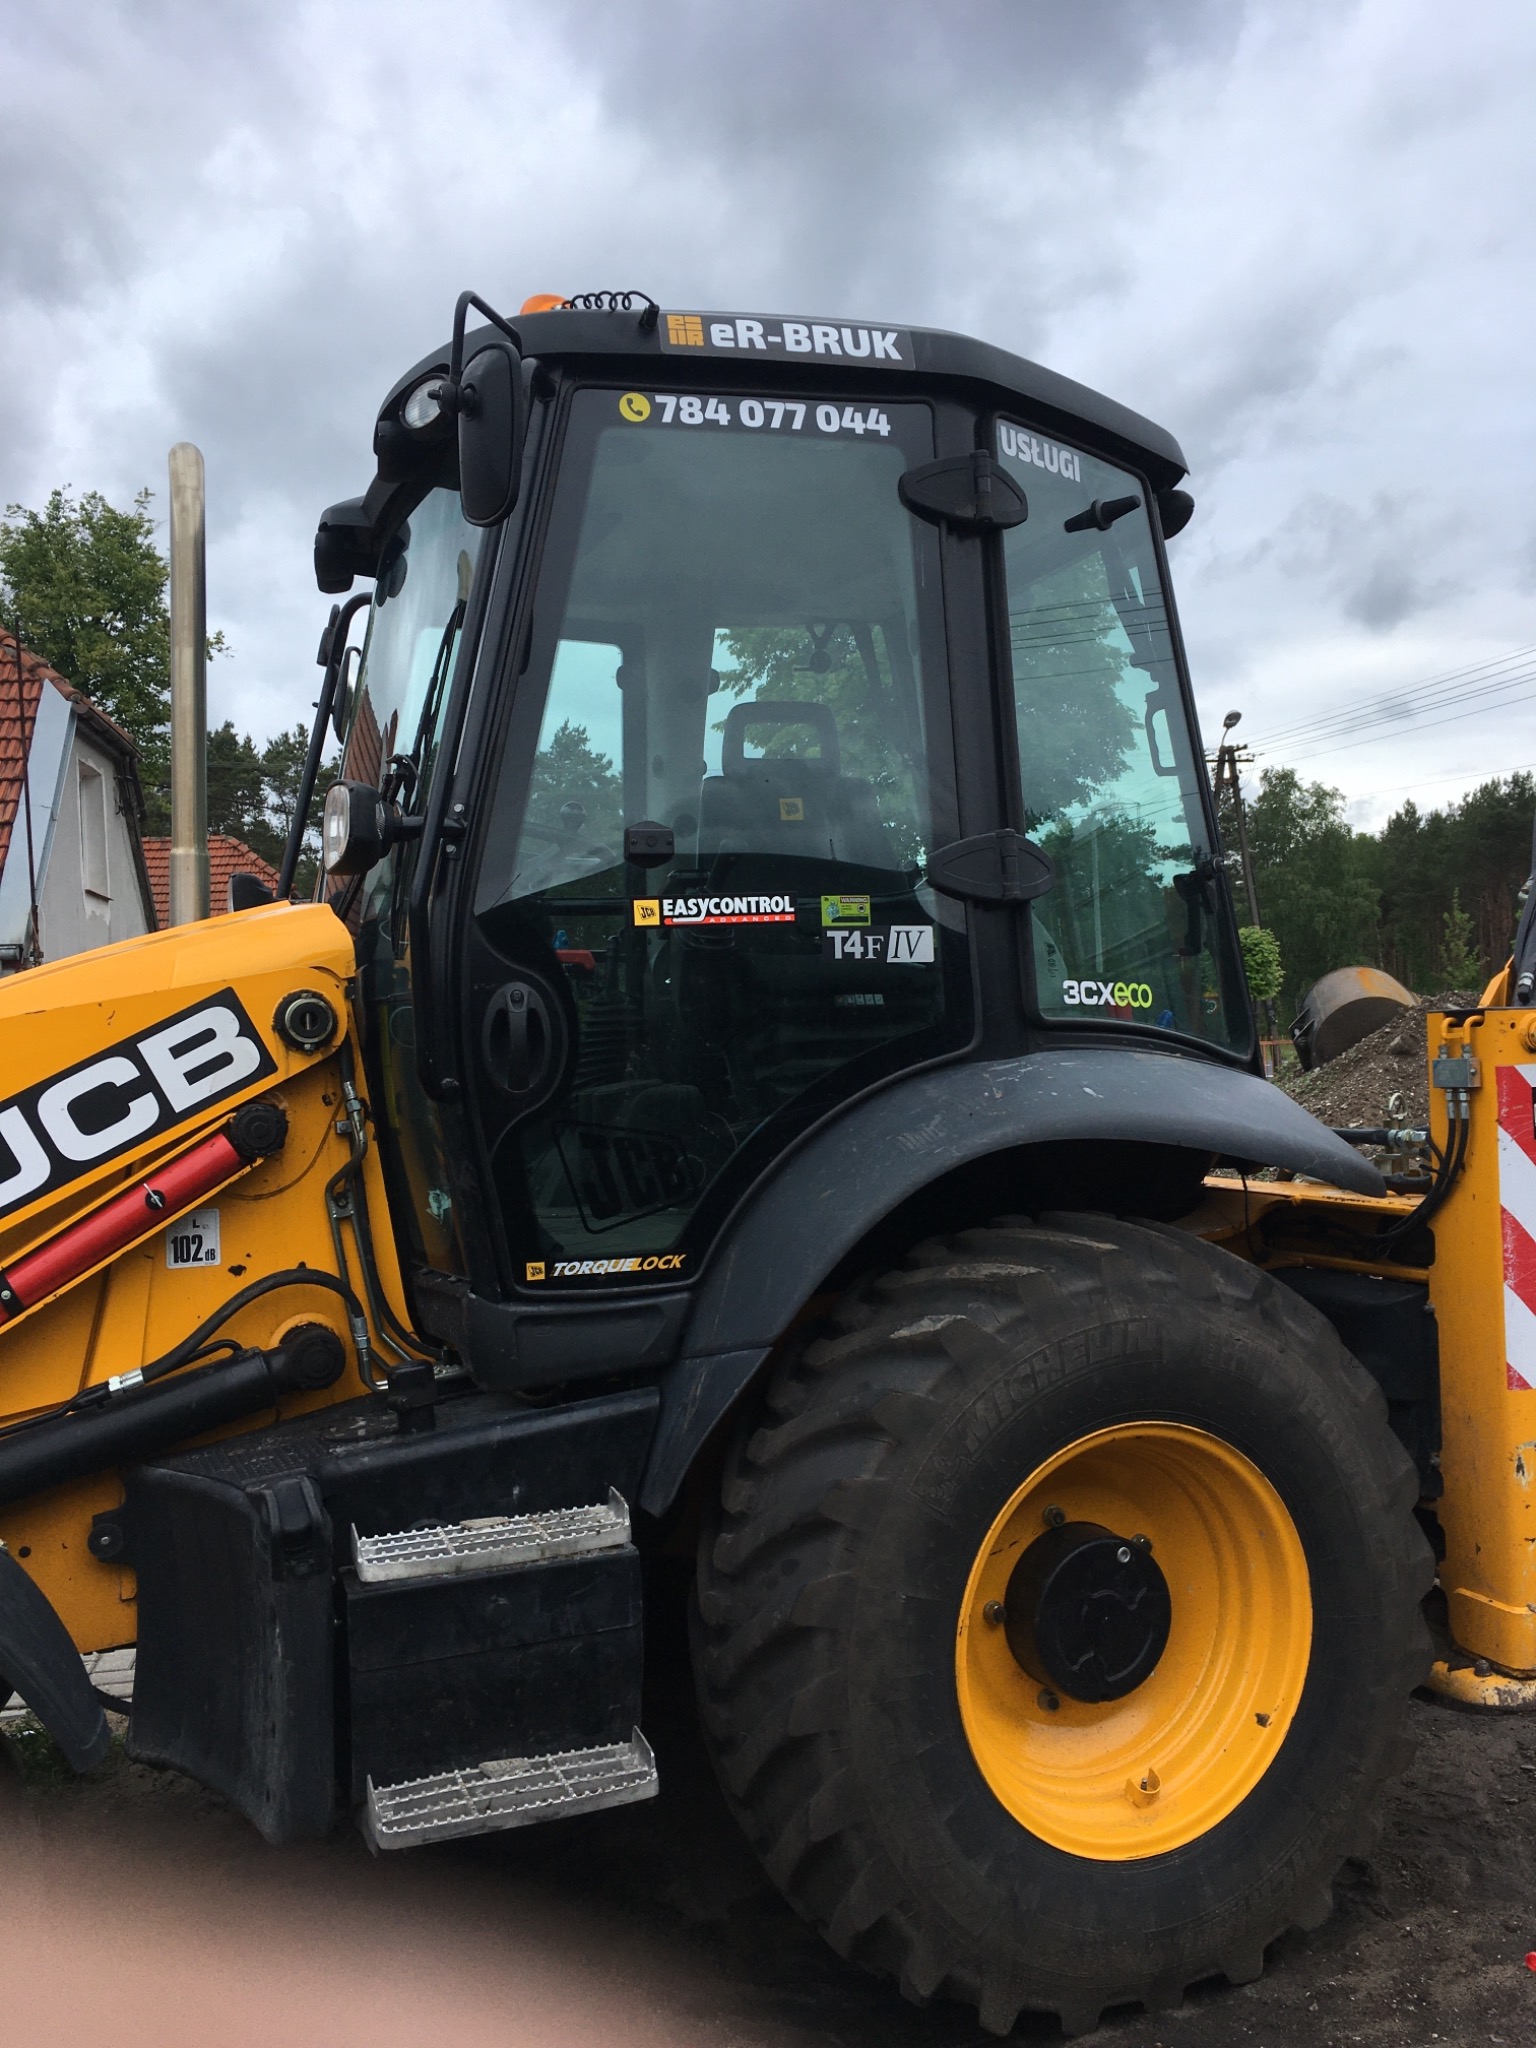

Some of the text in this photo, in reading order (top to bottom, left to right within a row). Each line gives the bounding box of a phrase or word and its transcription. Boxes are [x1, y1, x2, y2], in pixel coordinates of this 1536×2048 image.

[709, 319, 903, 361] eR-BRUK
[655, 395, 891, 437] 784 077 044
[1000, 425, 1082, 483] USŁUGI
[709, 915, 792, 923] ADVANCED
[826, 930, 926, 959] T4F IV
[171, 1234, 216, 1264] 102 dB
[553, 1254, 687, 1276] TORQUELOCK
[959, 1316, 1164, 1448] MICHELIN
